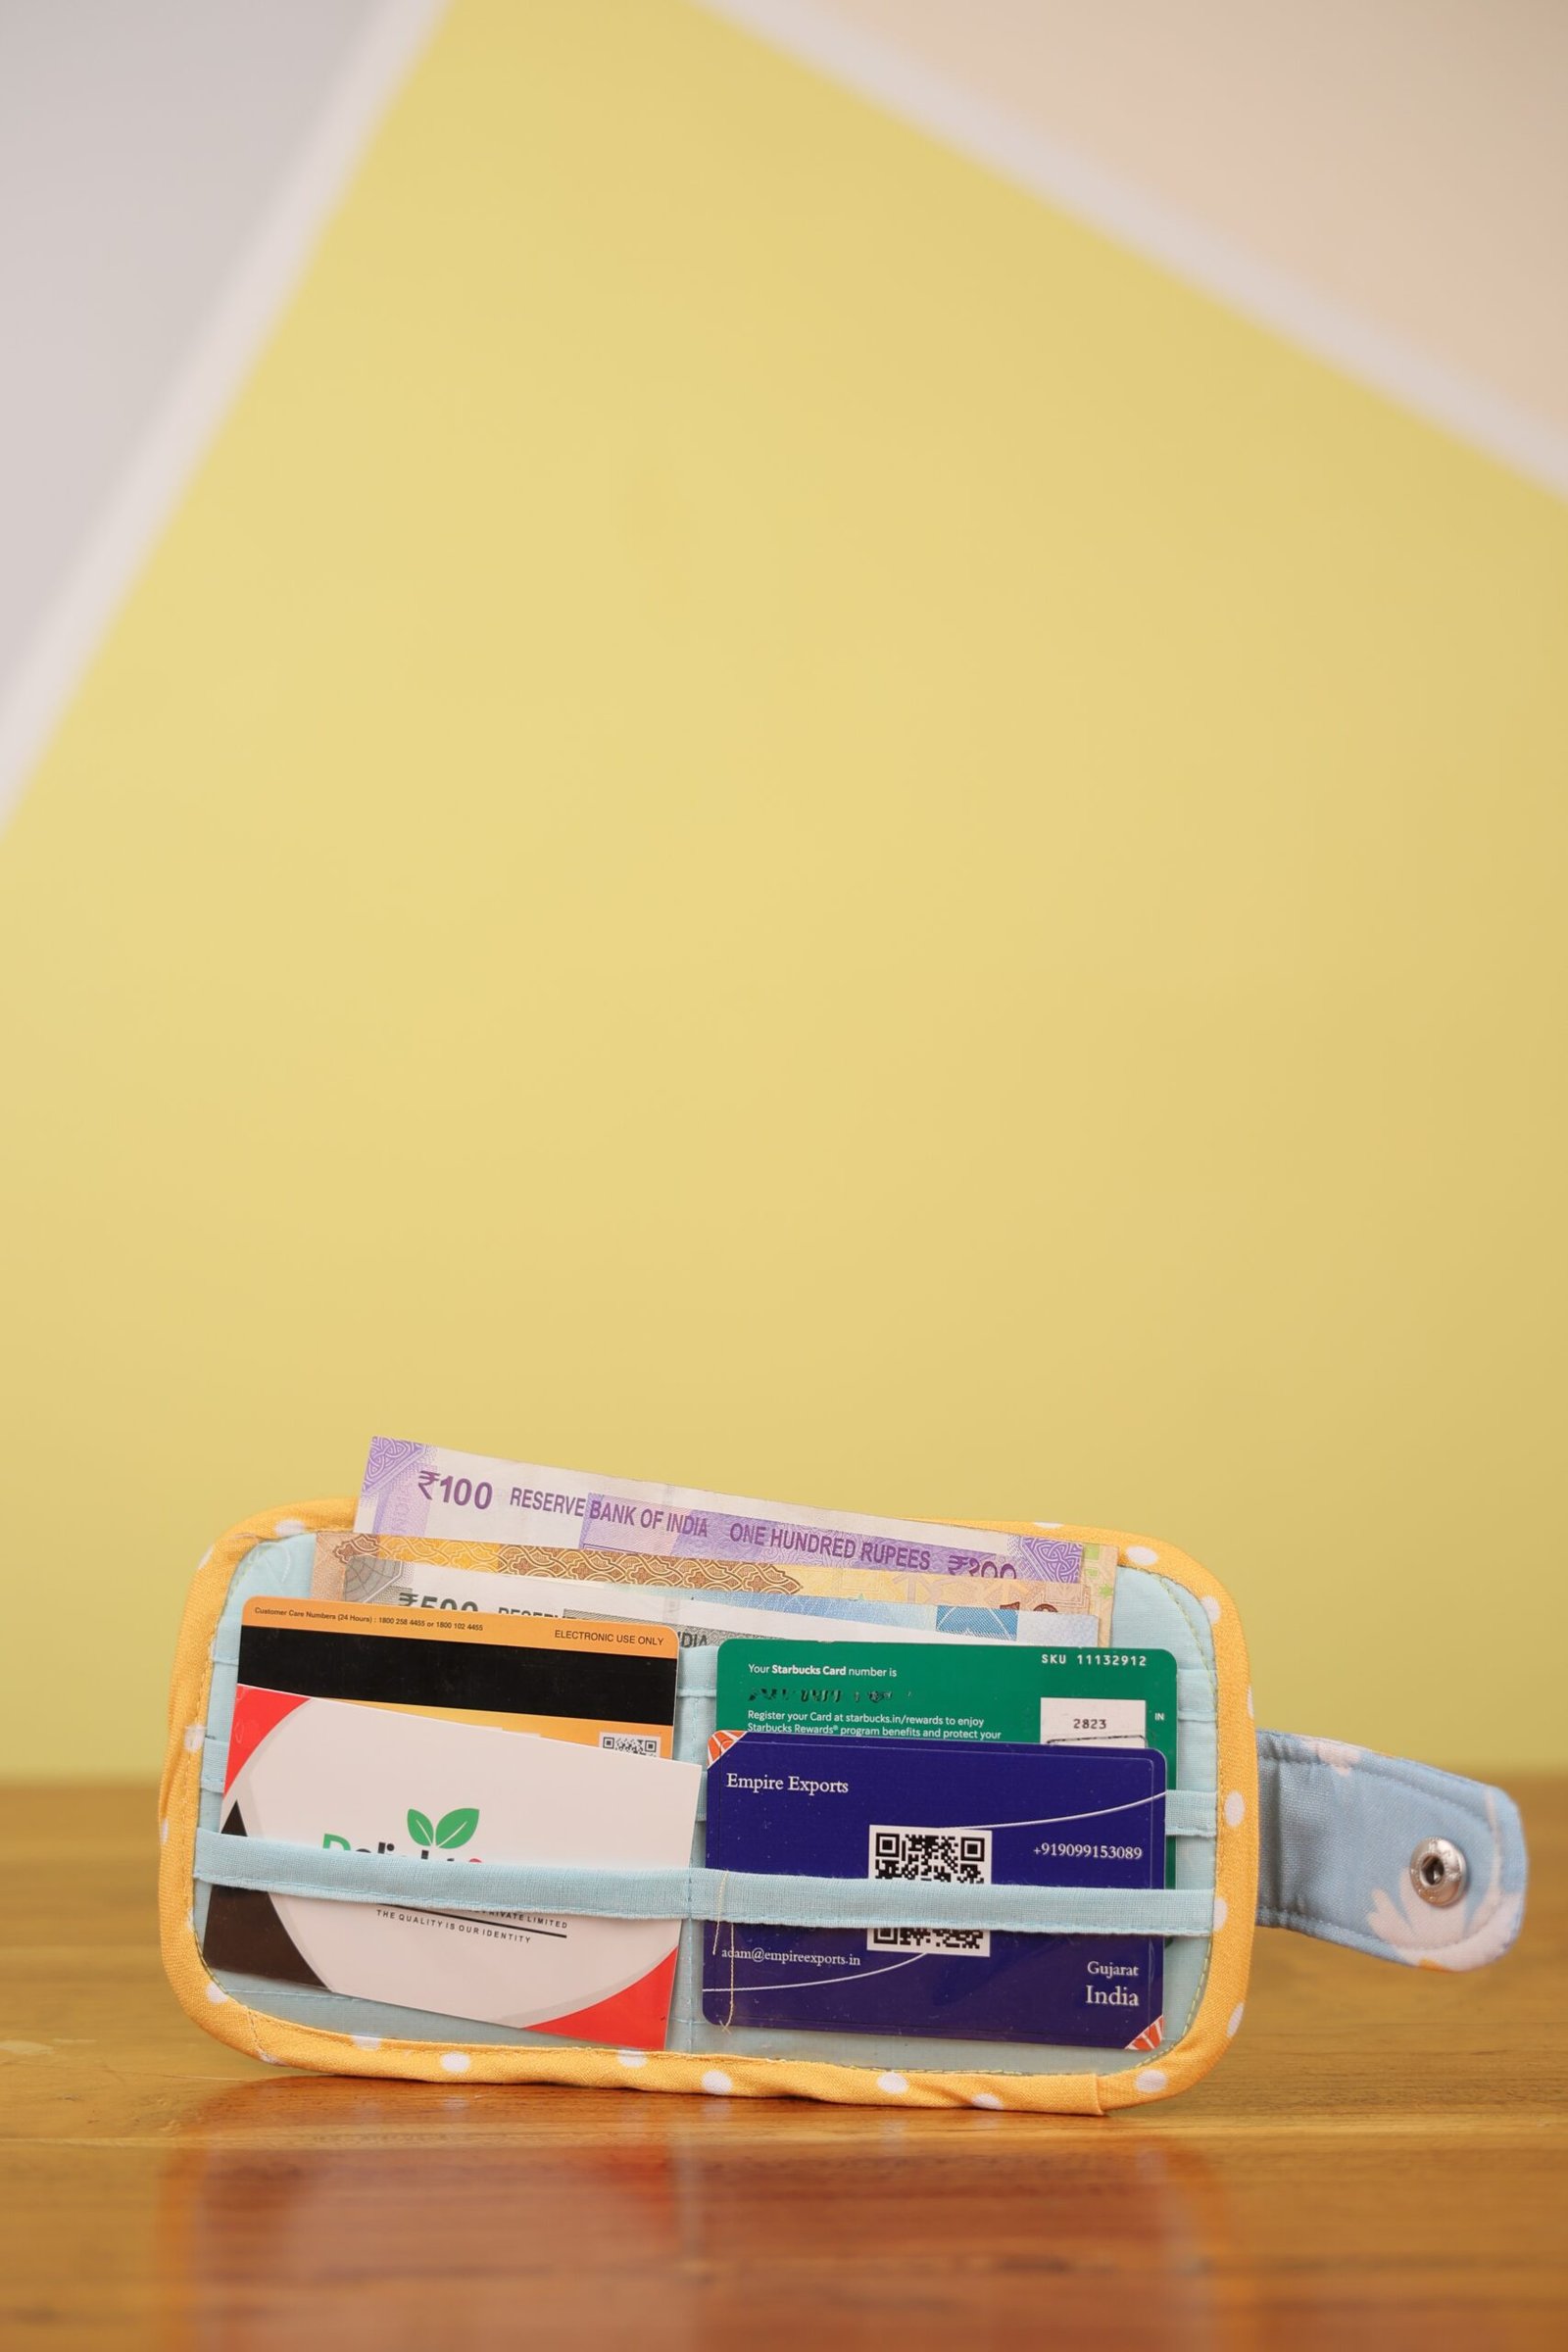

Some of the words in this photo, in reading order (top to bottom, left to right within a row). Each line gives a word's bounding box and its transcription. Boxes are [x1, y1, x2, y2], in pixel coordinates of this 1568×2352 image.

[417, 1470, 493, 1510] ₹100
[510, 1487, 585, 1518] RESERVE
[588, 1499, 636, 1527] BANK
[640, 1508, 664, 1530] OF
[666, 1512, 709, 1538] INDIA
[729, 1522, 767, 1545] ONE
[769, 1532, 857, 1560] HUNDRED
[860, 1542, 932, 1571] RUPEES
[254, 1607, 287, 1616] Customer
[288, 1609, 305, 1618] Care
[306, 1611, 336, 1620] Numbers
[555, 1629, 614, 1642] ELECTRONIC
[615, 1635, 635, 1644] USE
[637, 1636, 664, 1646] ONLY
[678, 1631, 709, 1648] DIA
[1041, 1653, 1067, 1665] SKU
[1076, 1654, 1147, 1667] 11132912
[748, 1663, 769, 1674] Your
[771, 1664, 821, 1676] Starbucks
[822, 1665, 846, 1676] Card
[849, 1666, 886, 1677] number
[888, 1667, 897, 1678] is
[748, 1709, 785, 1722] Register
[787, 1713, 808, 1722] your
[809, 1712, 832, 1722] Card
[845, 1713, 944, 1725] starbucks.in/rewards
[946, 1717, 956, 1726] to
[957, 1717, 984, 1728] enjoy
[1073, 1718, 1107, 1730] 2823
[1154, 1712, 1164, 1721] IN
[748, 1722, 793, 1733] Starbucks
[840, 1727, 880, 1737] program
[882, 1726, 921, 1738] benefits
[922, 1728, 941, 1738] and
[943, 1730, 979, 1740] protect
[980, 1732, 1002, 1741] your
[726, 1772, 784, 1793] Empire
[787, 1776, 850, 1796] Exports
[1034, 1842, 1143, 1859] +919099153089
[376, 1909, 396, 1919] THE
[398, 1914, 443, 1928] QUALITY
[445, 1922, 456, 1931] IS
[459, 1925, 480, 1935] OUR
[482, 1929, 531, 1944] IDENTITY
[527, 1916, 567, 1929] LIMITED
[721, 1946, 860, 1967] adam@empireexports.in
[1087, 1961, 1139, 1979] Gujarat
[1085, 1984, 1140, 2006] India
